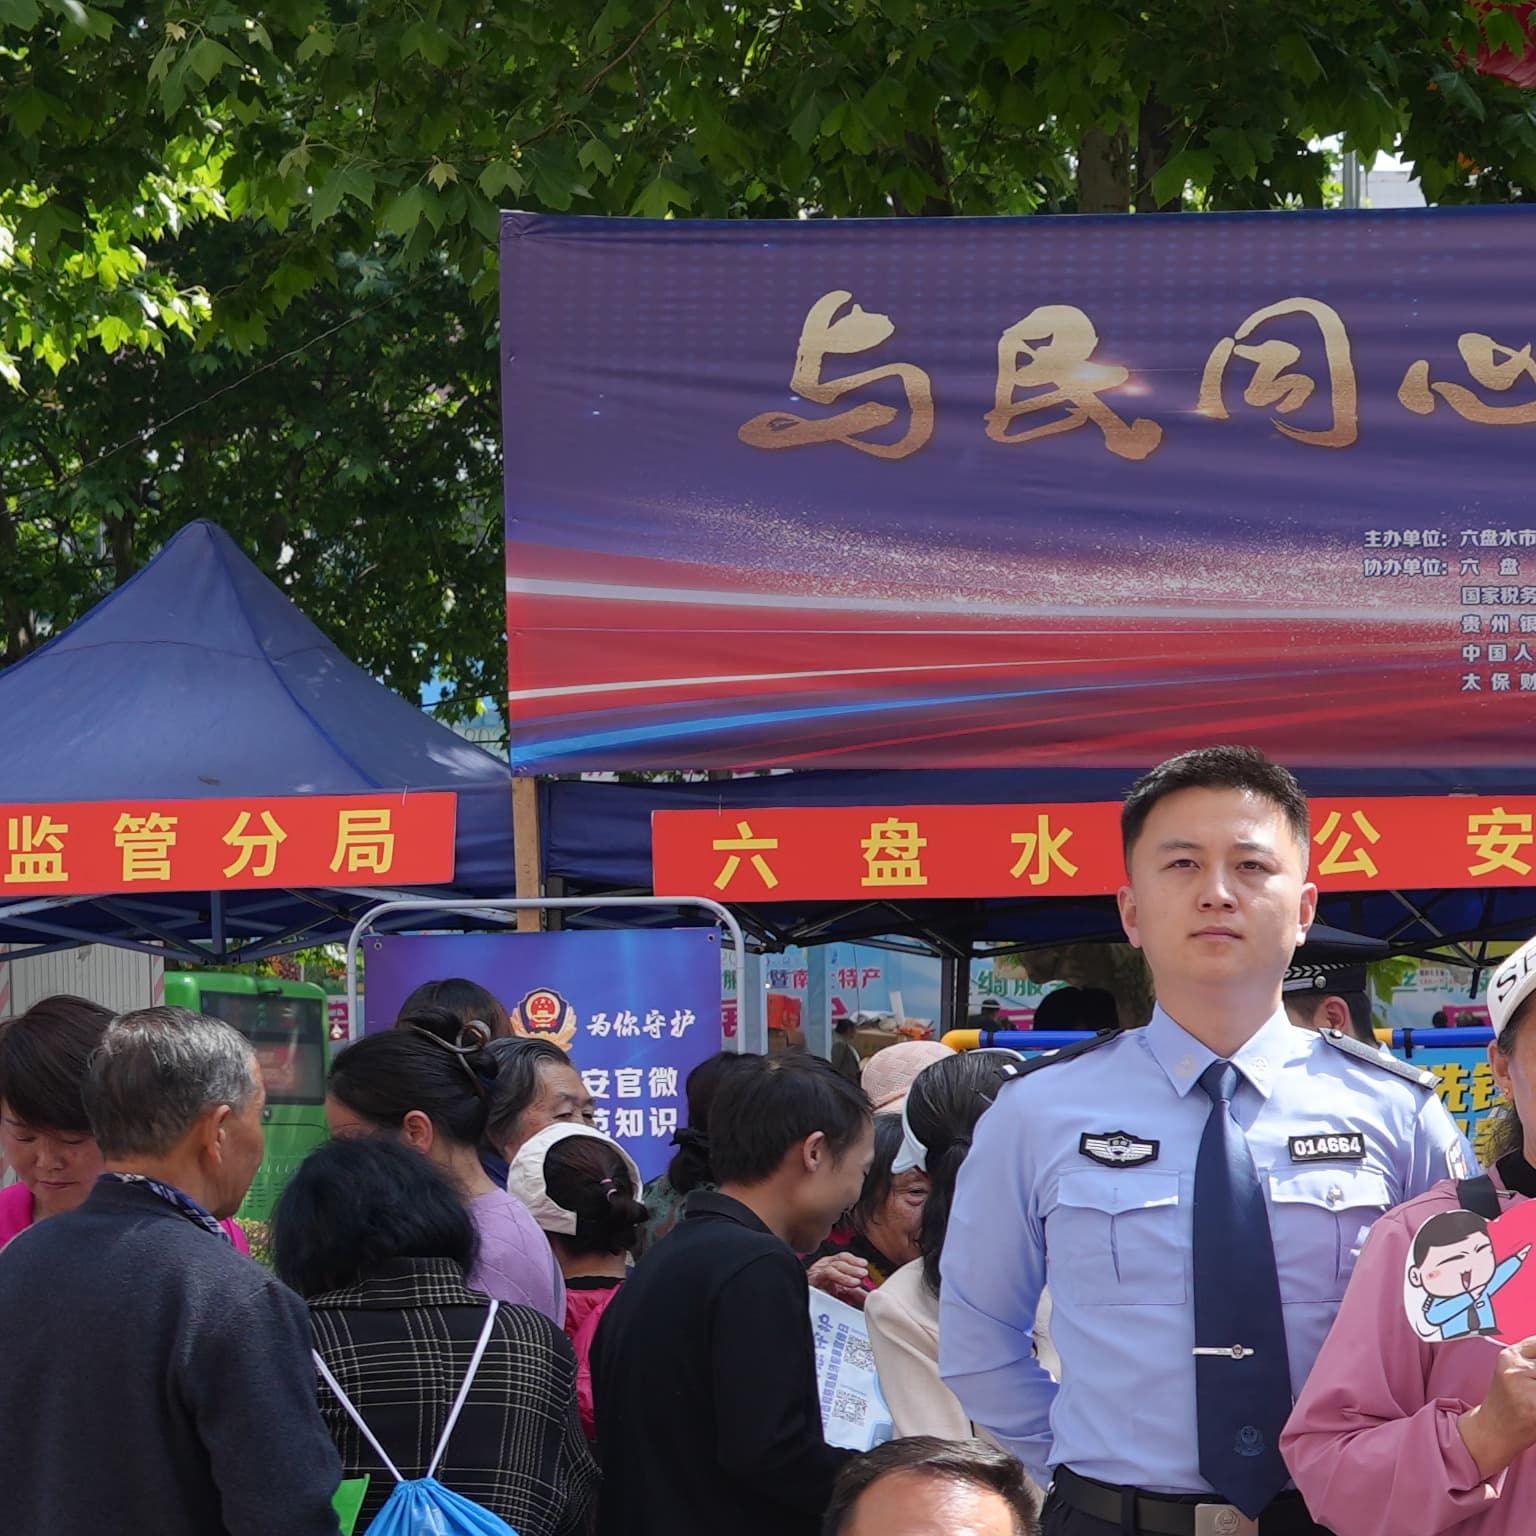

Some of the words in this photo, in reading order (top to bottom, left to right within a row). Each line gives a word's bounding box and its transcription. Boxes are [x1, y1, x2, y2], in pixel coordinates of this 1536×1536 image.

[586, 1008, 697, 1039] 为你守护
[1293, 1135, 1362, 1158] 014664
